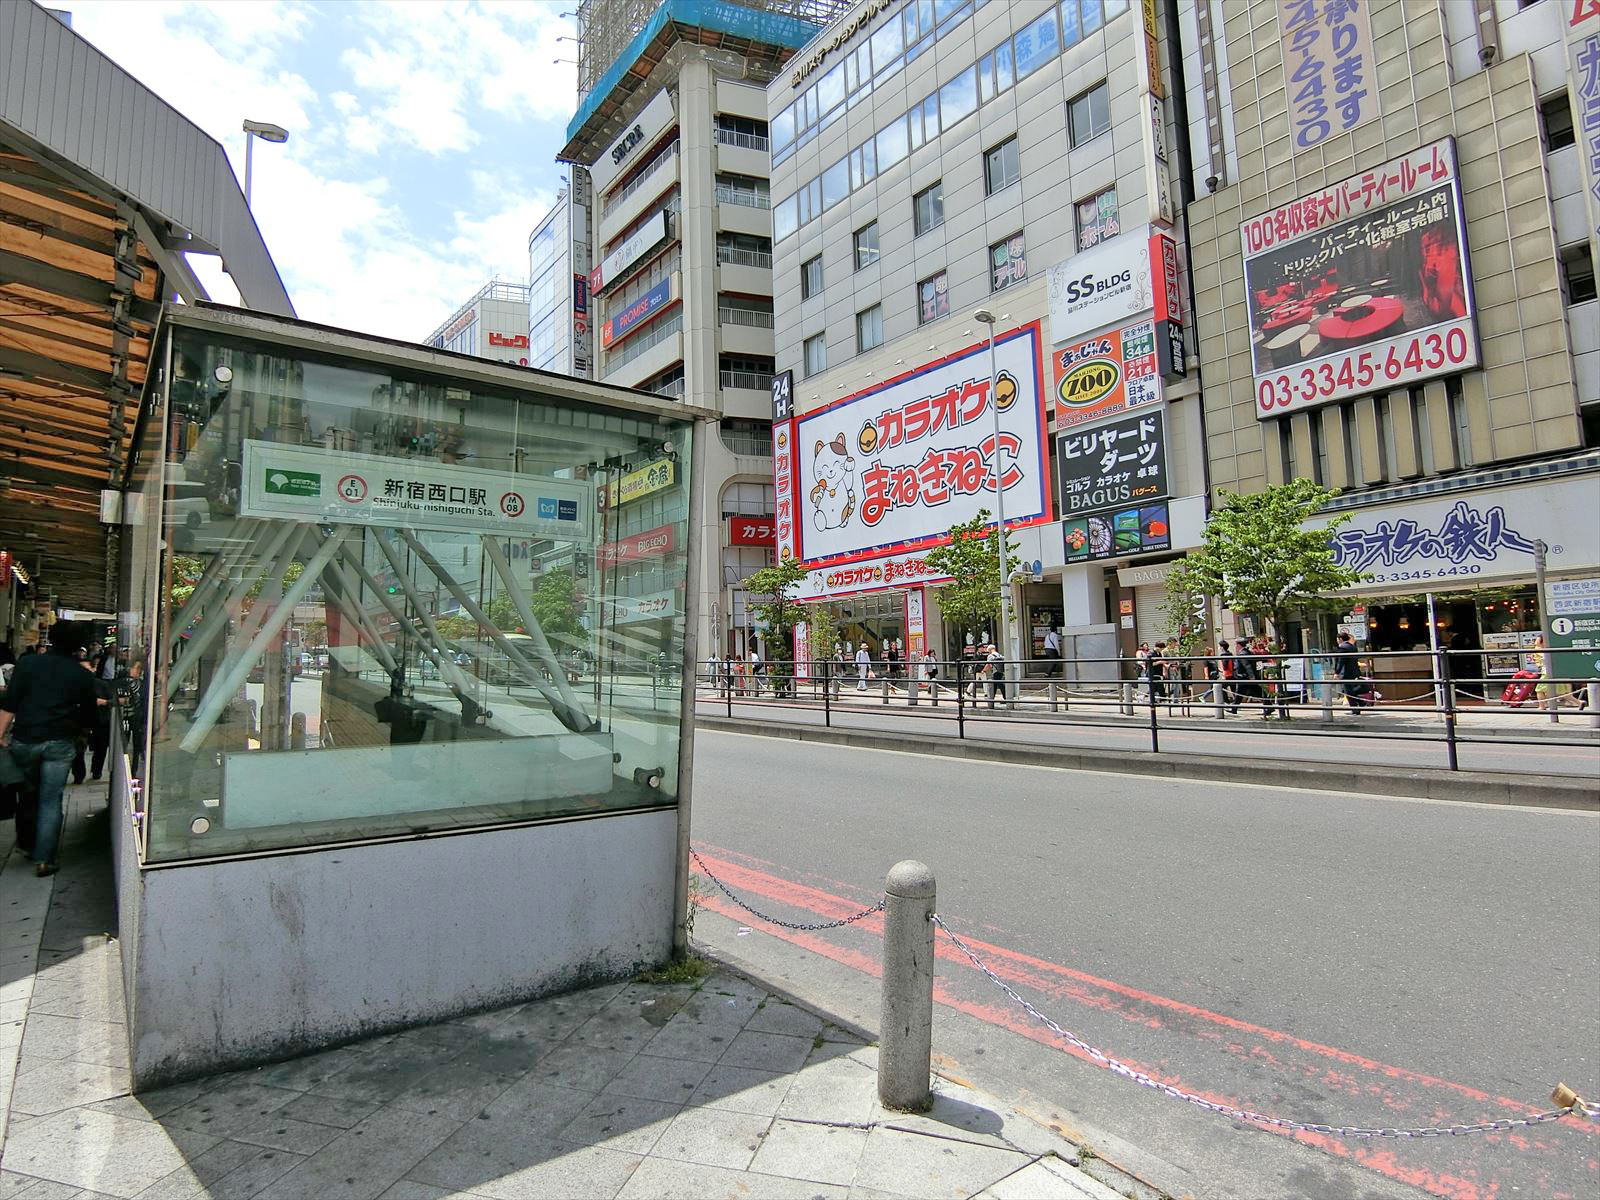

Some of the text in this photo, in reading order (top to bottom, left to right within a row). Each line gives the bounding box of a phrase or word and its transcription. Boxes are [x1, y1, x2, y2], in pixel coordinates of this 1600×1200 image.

[1243, 146, 1449, 254] 100名収容大パーティールーム
[1320, 191, 1447, 249] パーティールーム内
[1066, 269, 1132, 303] SS BLDG
[619, 297, 650, 330] PROMISE
[1067, 369, 1112, 397] ZOO
[1258, 327, 1468, 412] 03-3345-6430
[773, 380, 790, 402] 24
[776, 403, 787, 418] H
[876, 378, 993, 453] カラオケ
[1064, 417, 1156, 460] ビリヤード
[1099, 442, 1158, 474] ダーツ
[345, 488, 359, 498] 01
[384, 478, 487, 506] 新宿西口駅
[861, 430, 1024, 528] まねきねこ
[1066, 464, 1159, 494] ゴルフ カラオケ 卓球
[477, 506, 496, 518] Sta.
[506, 504, 519, 513] 08
[776, 453, 793, 542] カラオケ
[1070, 485, 1131, 510] BAGUS
[833, 566, 876, 588] カラオケ
[1133, 568, 1170, 582] BAGU
